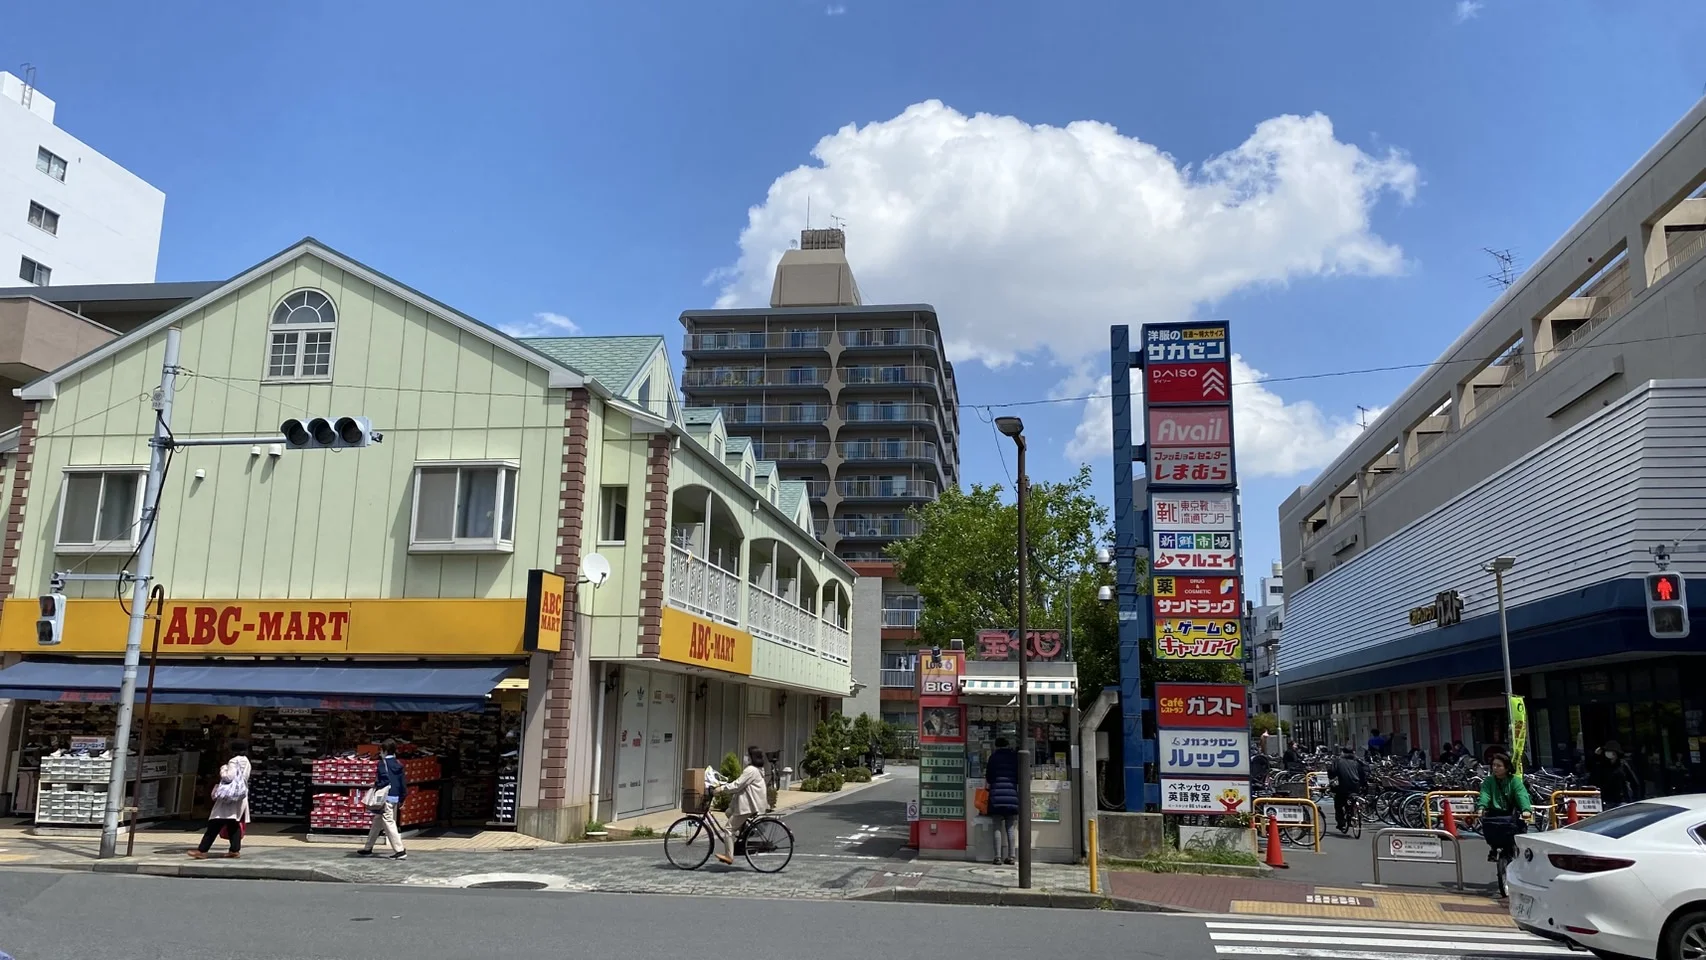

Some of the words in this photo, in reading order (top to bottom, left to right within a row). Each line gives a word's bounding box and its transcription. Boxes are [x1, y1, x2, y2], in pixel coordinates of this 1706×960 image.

[1148, 330, 1180, 341] 洋服の
[1148, 342, 1224, 360] サカゼン
[1153, 369, 1197, 378] DAISO
[1157, 418, 1222, 441] Avail
[1154, 451, 1227, 460] ファッションセンター
[1155, 463, 1227, 480] しまむら
[1157, 502, 1177, 522] 靴
[1181, 501, 1209, 511] 東京靴
[1181, 513, 1231, 524] 流通センター
[1160, 535, 1231, 548] 新鮮市場
[1175, 553, 1236, 567] マルエイ
[1157, 579, 1173, 594] 薬
[542, 591, 561, 616] ABC
[1158, 600, 1235, 613] サンドラッグ
[163, 606, 348, 645] ABC-MART
[541, 614, 560, 632] MART
[1178, 621, 1221, 635] ゲーム
[1225, 624, 1236, 633] 3F
[689, 622, 736, 662] ABC-MART
[979, 631, 1061, 658] 宝くじ
[1159, 635, 1240, 657] キャッツアイ
[925, 682, 953, 692] BIG
[1160, 698, 1183, 706] Café
[1187, 696, 1241, 715] ガスト
[1182, 738, 1237, 746] メガネサロン
[1168, 749, 1239, 767] ルック
[1168, 783, 1210, 791] ベネッセの
[1168, 792, 1211, 803] 英語教室
